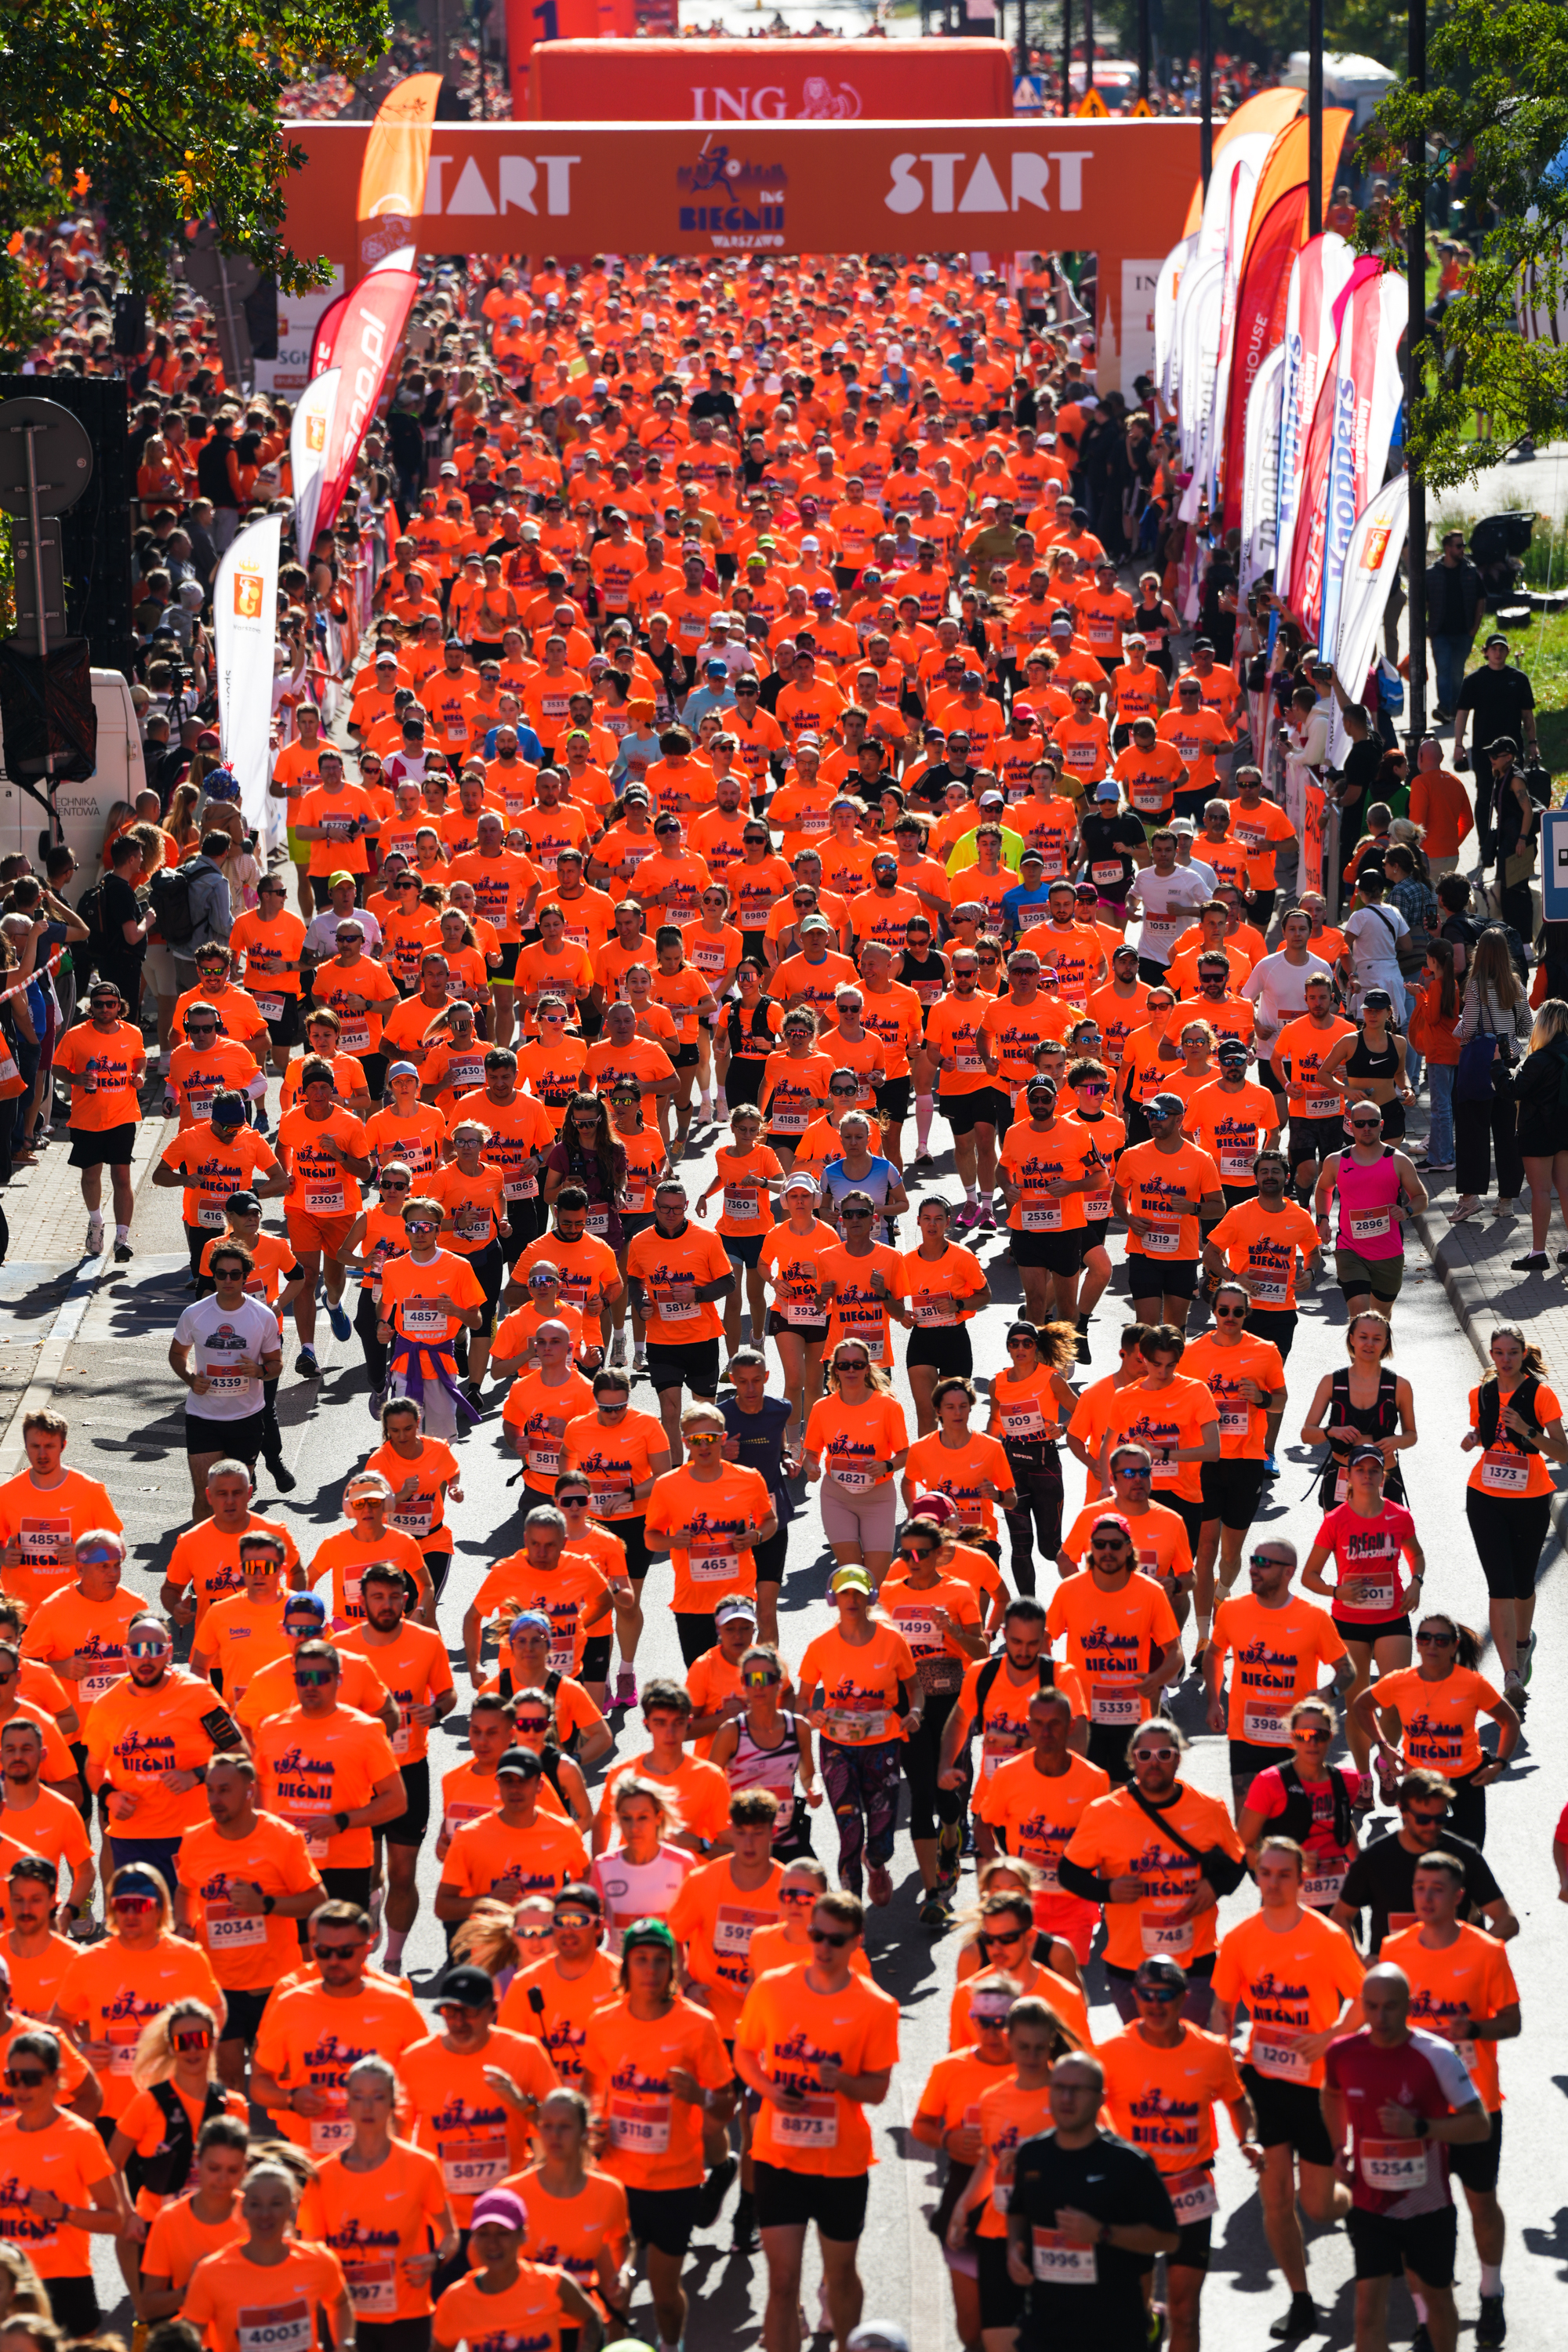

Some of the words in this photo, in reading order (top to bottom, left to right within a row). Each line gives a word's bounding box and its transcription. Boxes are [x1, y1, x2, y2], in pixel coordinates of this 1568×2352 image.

[691, 87, 788, 120] ING
[423, 156, 581, 216] TART
[884, 151, 1094, 213] START
[760, 191, 784, 203] ING
[680, 207, 784, 231] BIEGNIJ
[710, 235, 785, 248] WARSZAWO
[1246, 314, 1268, 383] HOUSE
[58, 807, 99, 815] ENTOWA
[1239, 832, 1258, 841] 7374
[697, 952, 717, 961] 4319
[251, 961, 267, 970] BIEG
[1058, 973, 1083, 982] IEGNIJ
[457, 1067, 479, 1076] 3430
[196, 1102, 212, 1110] 286
[1217, 1138, 1255, 1147] BIEGNIJ
[1217, 1138, 1254, 1148] BIEGNIJ
[299, 1167, 336, 1177] BIEGNIJ
[201, 1181, 239, 1192] BIEGNIJ
[511, 1181, 533, 1191] 1865
[311, 1196, 337, 1204] 2302
[728, 1200, 750, 1209] 7360
[204, 1212, 221, 1221] 416
[1356, 1219, 1382, 1230] 2896
[1250, 1255, 1290, 1269] BIEGNIJ
[1250, 1256, 1290, 1269] BIEGNIJ
[1254, 1284, 1279, 1293] 224
[666, 1303, 690, 1312] 5812
[410, 1312, 437, 1321] 4857
[840, 1308, 882, 1323] BIEGNIJ
[212, 1377, 241, 1388] 4339
[1009, 1416, 1030, 1425] 909
[536, 1454, 559, 1463] 5811
[838, 1473, 865, 1483] 4821
[1490, 1468, 1516, 1479] 1373
[394, 1515, 425, 1526] 4394
[30, 1534, 60, 1544] 4851
[702, 1559, 726, 1570] 465
[899, 1622, 931, 1632] 1499
[1086, 1658, 1137, 1671] BIEGNIJ
[1242, 1673, 1294, 1687] BIEGNIJ
[1099, 1703, 1131, 1711] 5339
[1410, 1744, 1461, 1758] BIEGNIJ
[123, 1756, 175, 1771] BIEGNIJ
[278, 1784, 332, 1798] BIEGNIJ
[1305, 1879, 1338, 1892] 8872
[216, 1922, 252, 1934] 2034
[1265, 2046, 1294, 2063] 1201
[1133, 2127, 1197, 2144] BIEGNIJ
[455, 2163, 494, 2176] 5877
[250, 2326, 299, 2342] 4003
